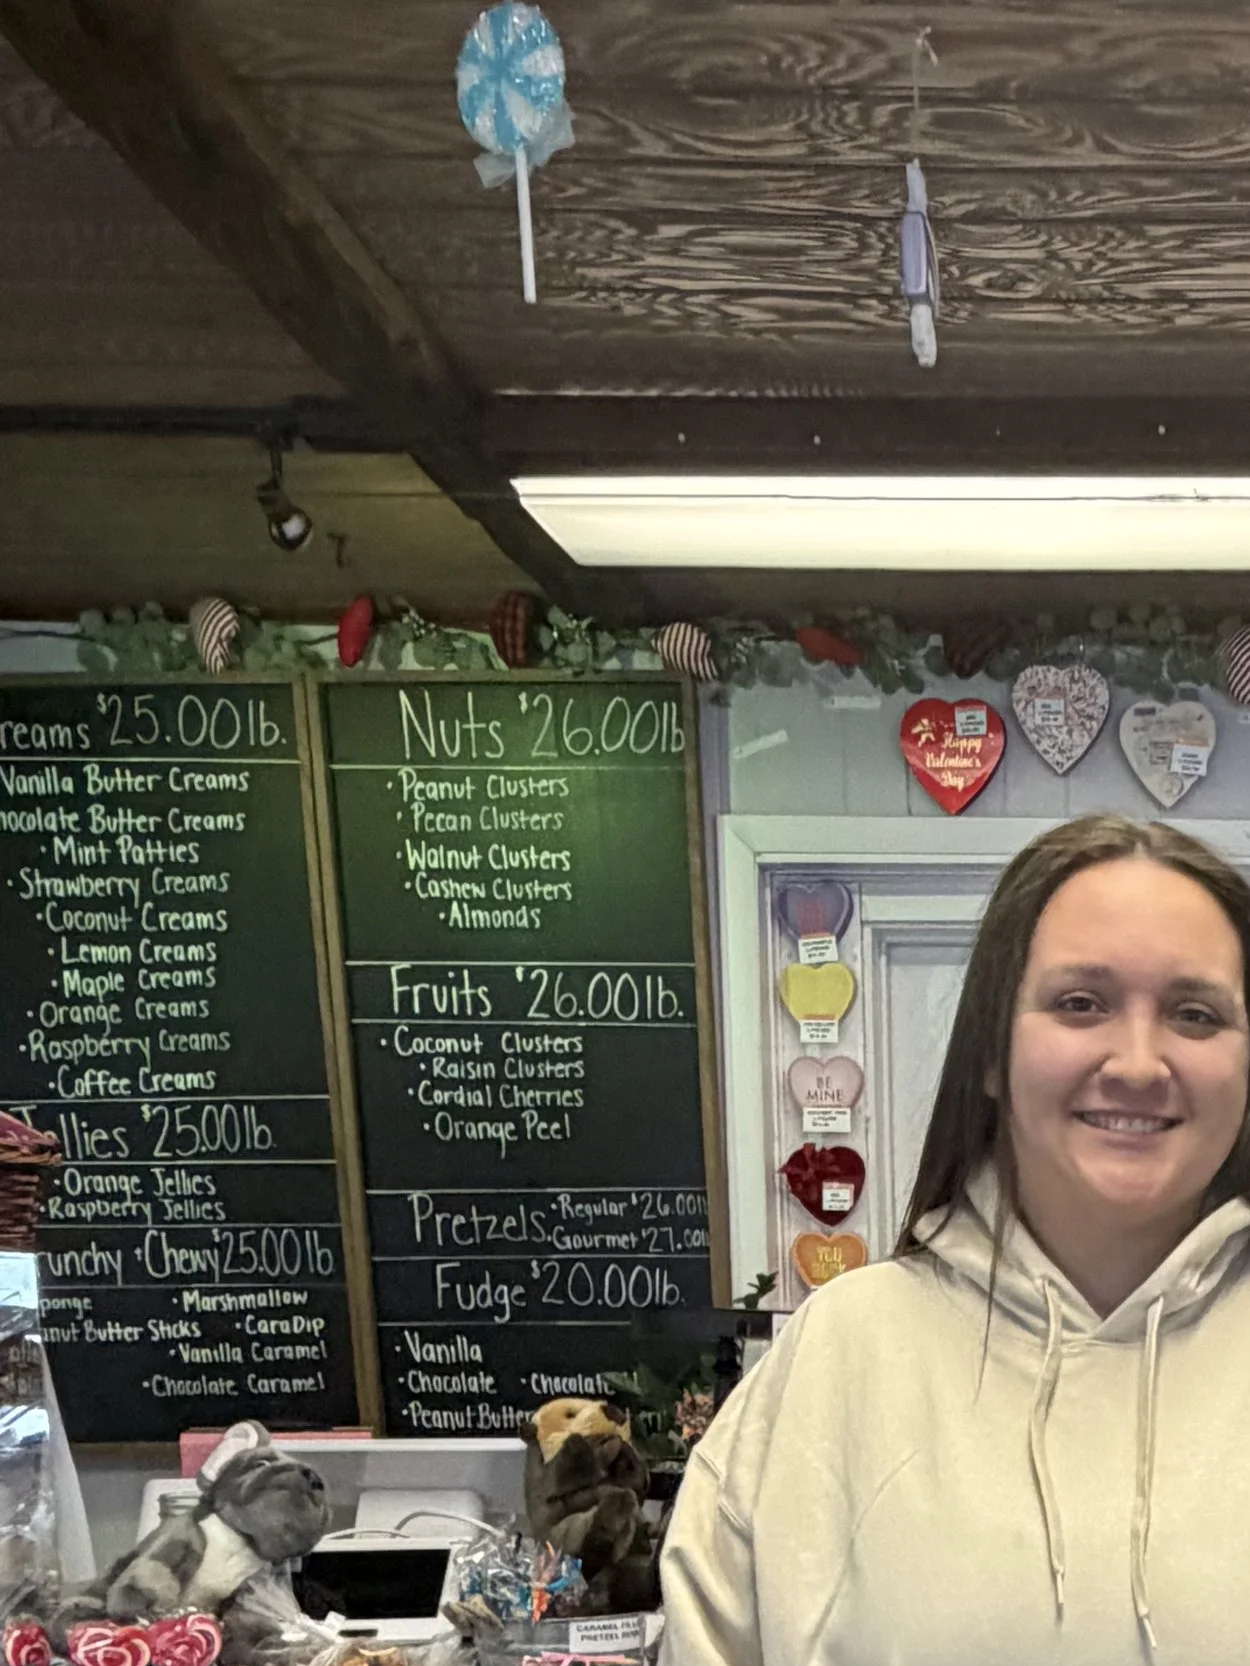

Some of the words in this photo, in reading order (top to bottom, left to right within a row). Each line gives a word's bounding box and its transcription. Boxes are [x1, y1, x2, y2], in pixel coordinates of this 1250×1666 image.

[0, 720, 91, 750] reams
[399, 689, 505, 760] Nuts
[0, 765, 74, 796] Vanilla
[83, 763, 162, 796] Butter
[168, 766, 250, 793] Creams
[398, 767, 476, 802] Peanut
[487, 774, 570, 799] Clusters
[0, 806, 80, 833] ocolate
[87, 803, 161, 834] Butter
[168, 808, 246, 833] Creams
[410, 802, 472, 833] Pecan
[479, 806, 564, 832] Clusters
[53, 835, 111, 866] Mint
[116, 835, 200, 865] Patties
[406, 839, 483, 871] Walnut
[488, 844, 571, 871] Clusters
[19, 866, 141, 908] Strawberry
[152, 867, 231, 895] Creams
[415, 872, 486, 900] Cashew
[492, 877, 573, 901] Clusters
[46, 901, 133, 932] Coconut
[141, 901, 228, 932] Creams
[449, 901, 541, 929] Almonds
[61, 936, 132, 964] Lemon
[139, 938, 217, 964] Creams
[63, 968, 125, 1001] Maple
[138, 966, 216, 989] Creams
[390, 964, 492, 1017] Fruits
[39, 1001, 122, 1036] Orange
[135, 997, 210, 1019] Creams
[28, 1028, 151, 1067] Raspberry
[158, 1029, 231, 1053] Creams
[393, 1025, 485, 1057] Coconut
[501, 1032, 583, 1055] Clusters
[58, 1065, 131, 1099] Coffee
[139, 1067, 216, 1092] Creams
[432, 1057, 495, 1080] Raisin
[504, 1057, 585, 1080] Clusters
[816, 1076, 831, 1089] BE
[418, 1080, 493, 1109] Cordial
[499, 1081, 584, 1110] Cherries
[806, 1089, 843, 1102] MINE
[434, 1111, 518, 1160] Orange
[521, 1111, 571, 1141] Peel
[64, 1168, 143, 1201] Orange
[150, 1168, 216, 1196] Jellies
[49, 1197, 151, 1226] Raspberry
[163, 1200, 226, 1221] Jellies
[407, 1192, 547, 1247] Pretzels
[556, 1193, 628, 1226] Regular
[553, 1225, 639, 1250] Gourmet
[37, 1240, 122, 1287] unchy
[144, 1229, 219, 1284] Chewy
[182, 1288, 308, 1313] Marshmallow
[436, 1261, 527, 1324] Fudge
[39, 1297, 93, 1320] ponge
[83, 1319, 144, 1343] Butter
[148, 1319, 202, 1341] Sticks
[177, 1342, 243, 1364] Vanilla
[250, 1340, 328, 1362] Caramel
[404, 1329, 483, 1365] Vanilla
[151, 1374, 239, 1397] Chocolate
[247, 1371, 325, 1394] Caramel
[408, 1369, 497, 1395] Chocolate
